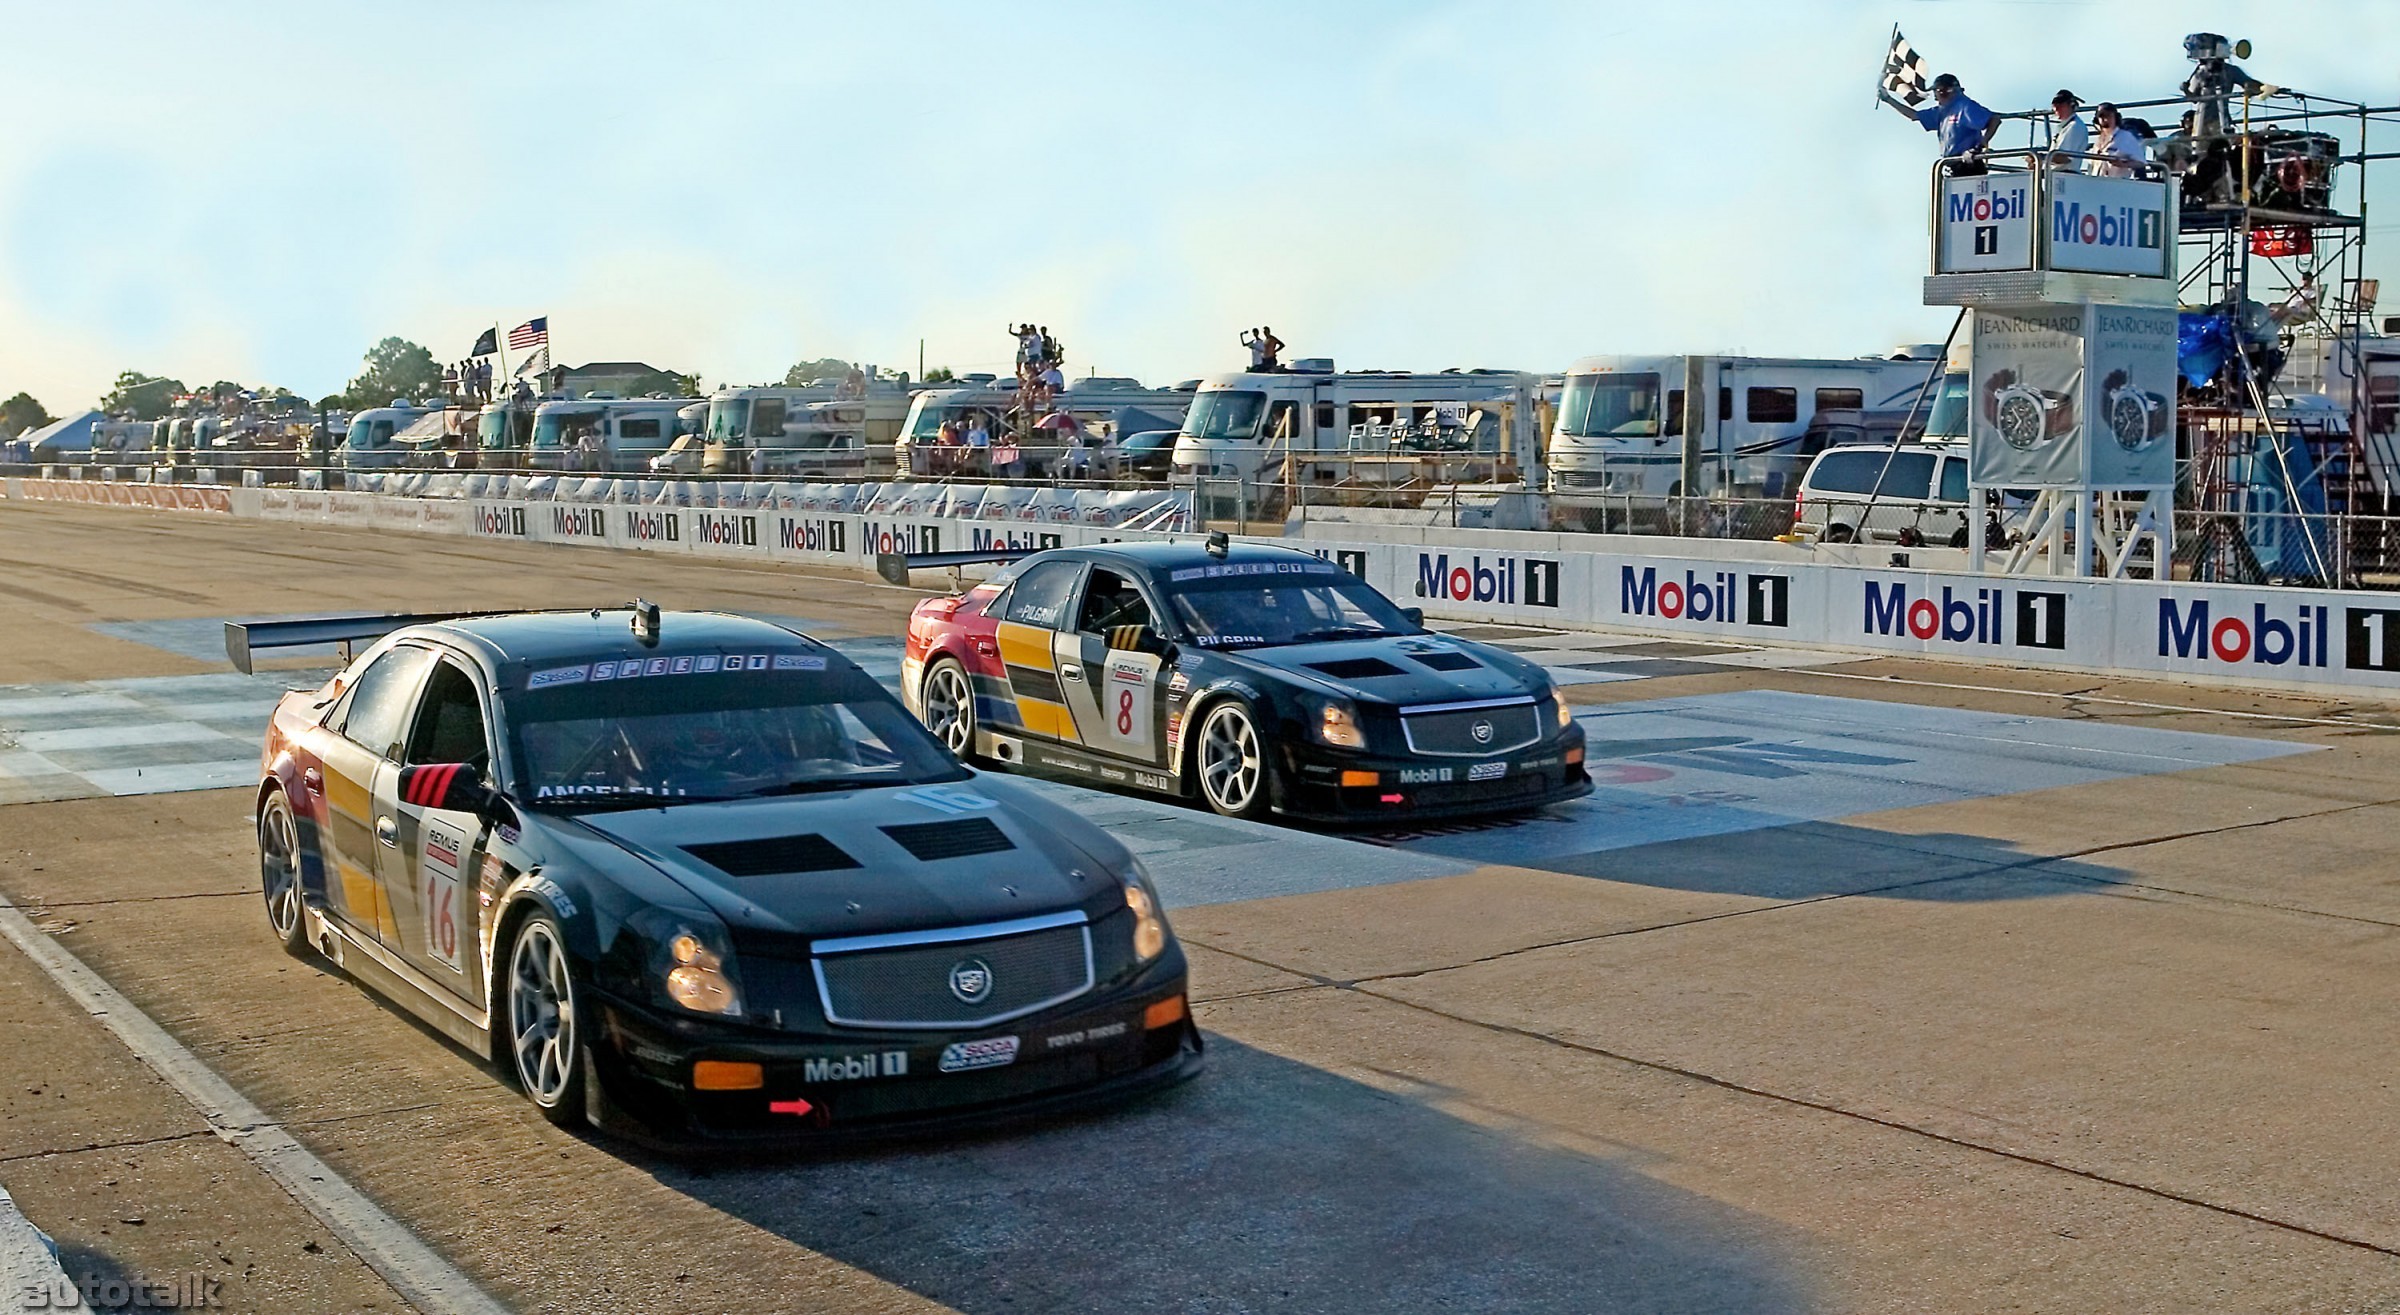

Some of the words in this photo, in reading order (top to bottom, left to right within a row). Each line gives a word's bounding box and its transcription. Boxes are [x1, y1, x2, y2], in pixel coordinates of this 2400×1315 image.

[1950, 189, 2025, 222] Mobil
[2053, 201, 2133, 247] Mobil
[2144, 213, 2154, 246] 1
[1979, 316, 2081, 337] JEANRICHARD
[2099, 315, 2175, 336] JEANRICHARD
[1987, 340, 2017, 350] SWISS
[2022, 339, 2069, 350] WATCHES
[475, 506, 511, 535] Mobil
[553, 507, 590, 536] Mobil
[628, 512, 664, 541] Mobil
[699, 514, 740, 545] Mobil
[780, 518, 826, 551] Mobil
[863, 522, 916, 555] Mobil
[1418, 553, 1515, 604] Mobil
[1534, 564, 1546, 603] 1
[1621, 565, 1736, 624] Mobil
[1758, 579, 1774, 623] 1
[1864, 580, 2002, 645] Mobil
[2030, 596, 2048, 644] 1
[2158, 598, 2328, 667] Mobil
[2362, 613, 2384, 667] 1
[1117, 690, 1133, 736] 8
[1135, 771, 1158, 788] Mobil
[1400, 769, 1437, 784] Mobil
[893, 786, 1000, 815] 16
[428, 829, 461, 852] REMUS
[427, 875, 456, 959] 16
[965, 1040, 1014, 1056] SCCA
[804, 1058, 879, 1083] Mobil
